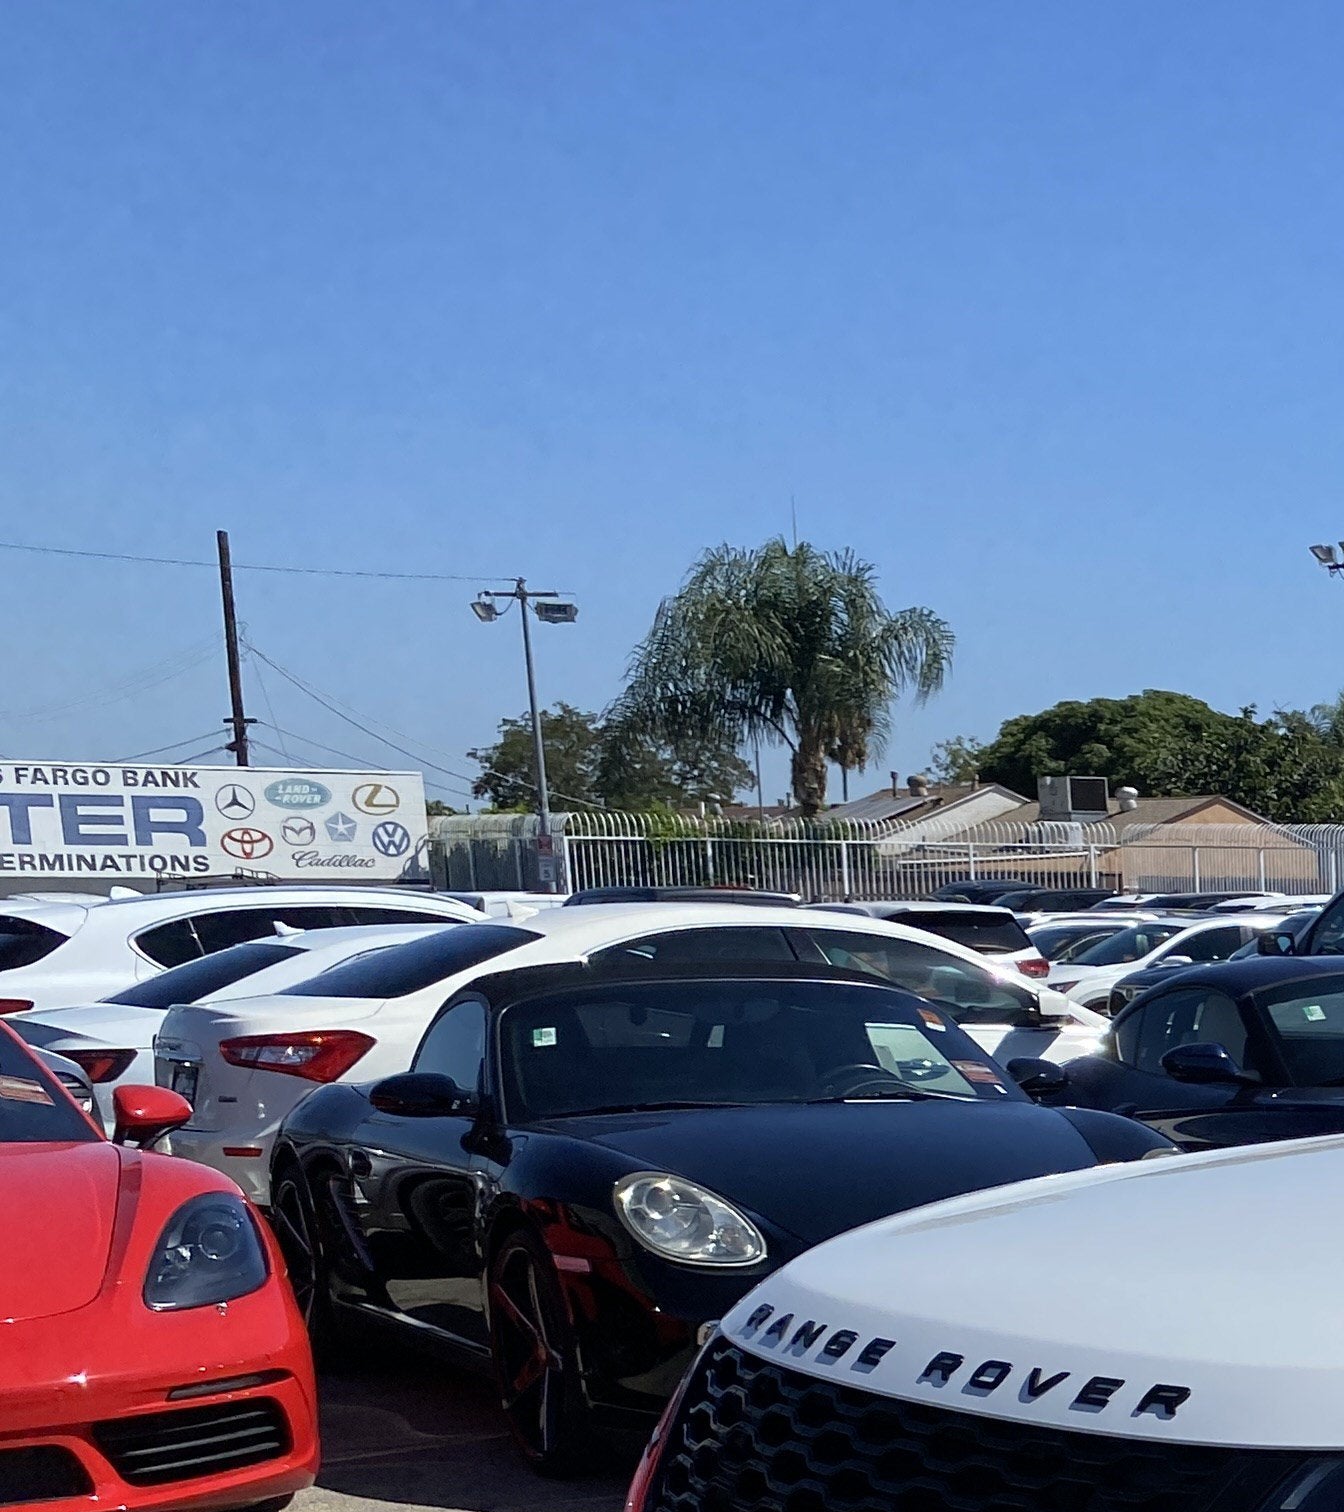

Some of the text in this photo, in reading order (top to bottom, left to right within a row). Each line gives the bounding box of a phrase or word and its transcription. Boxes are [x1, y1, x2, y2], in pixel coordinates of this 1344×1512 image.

[14, 766, 111, 787] FARGO
[121, 769, 201, 789] BANK
[282, 793, 322, 804] ROVER
[291, 850, 376, 868] Cadillac
[746, 1302, 1192, 1415] RANGE ROVER
